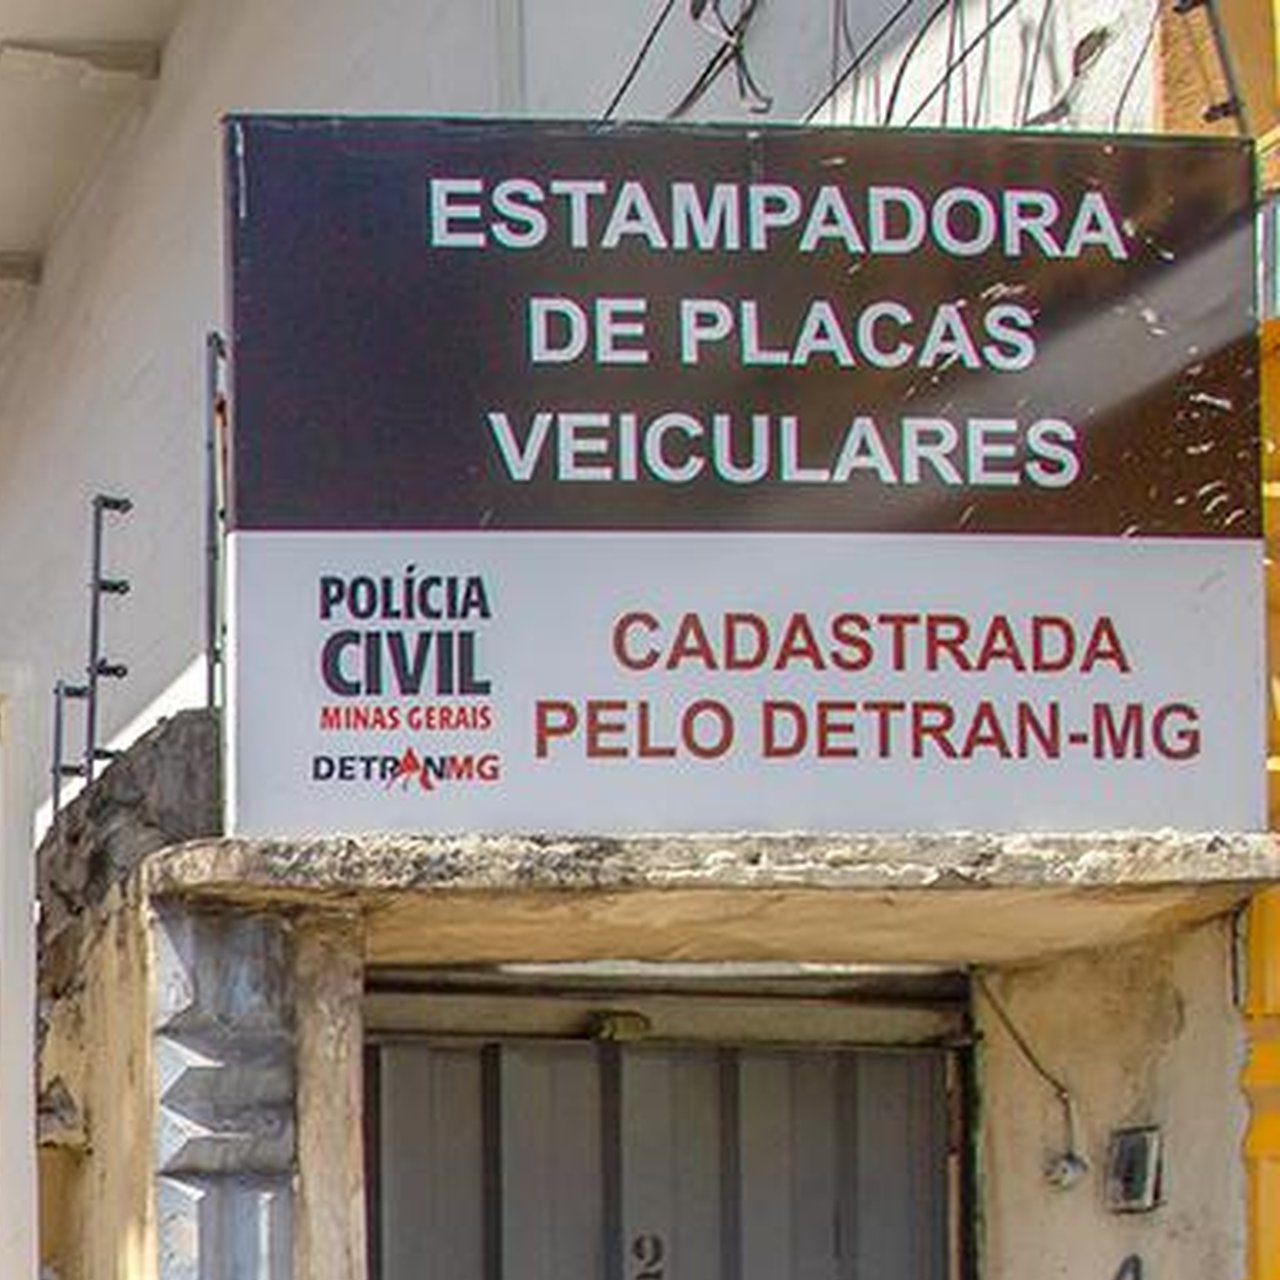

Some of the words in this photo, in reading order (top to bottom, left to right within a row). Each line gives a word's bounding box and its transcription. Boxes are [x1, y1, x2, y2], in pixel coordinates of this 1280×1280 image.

[428, 178, 1130, 259] ESTAMPADORA
[529, 298, 648, 364] DE
[679, 300, 1037, 372] PLACAS
[488, 411, 1082, 488] VEICULARES
[319, 564, 492, 620] POLÍCIA
[320, 629, 492, 697] CIVIL
[612, 612, 1132, 673] CADASTRADA
[320, 705, 401, 731] MINAS
[406, 705, 492, 731] GERAIS
[534, 700, 735, 759] PELO
[761, 700, 1202, 761] DETRAN-MG
